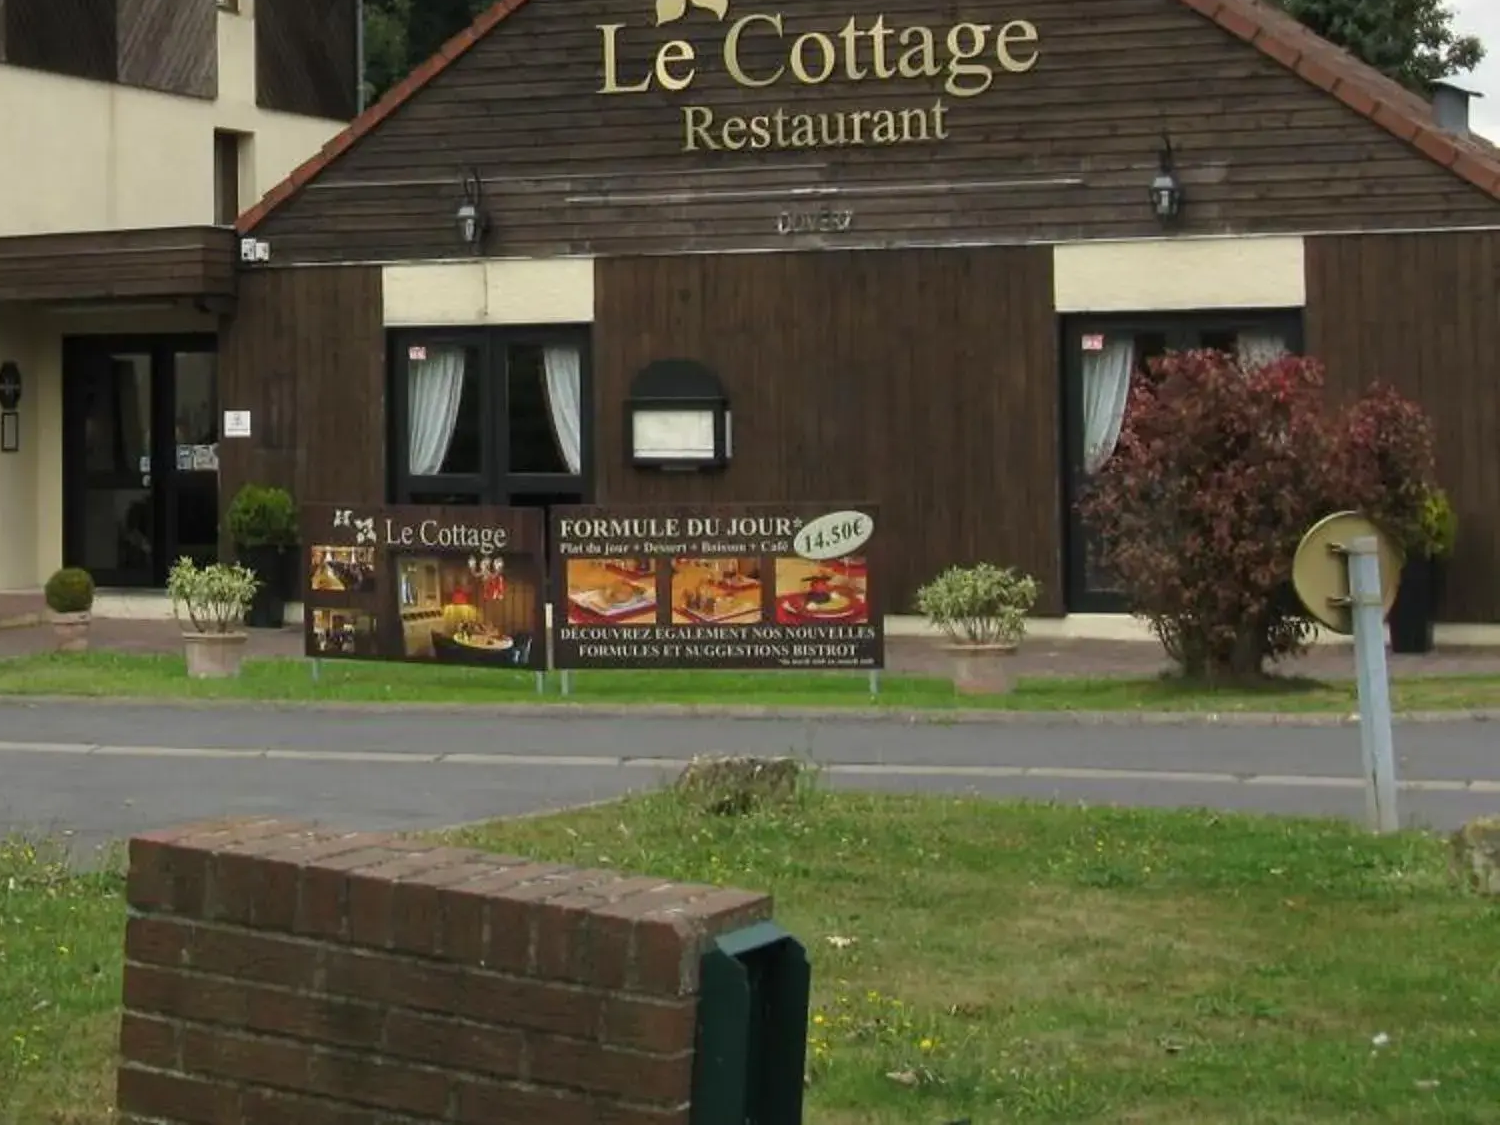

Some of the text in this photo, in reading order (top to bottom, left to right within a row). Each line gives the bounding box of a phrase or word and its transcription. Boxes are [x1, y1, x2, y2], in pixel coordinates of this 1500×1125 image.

[596, 13, 1040, 97] Le Cottage
[680, 98, 949, 151] Restaurant
[385, 518, 508, 554] Le Cottage
[560, 518, 680, 537] FORMULE
[687, 518, 719, 537] DU
[560, 542, 583, 554] Plat
[585, 542, 601, 554] du
[752, 627, 782, 640] NOS
[785, 627, 876, 640] NOUVELLES
[579, 644, 857, 657] FORMULES ET SUGGESTIONS BISTROT
